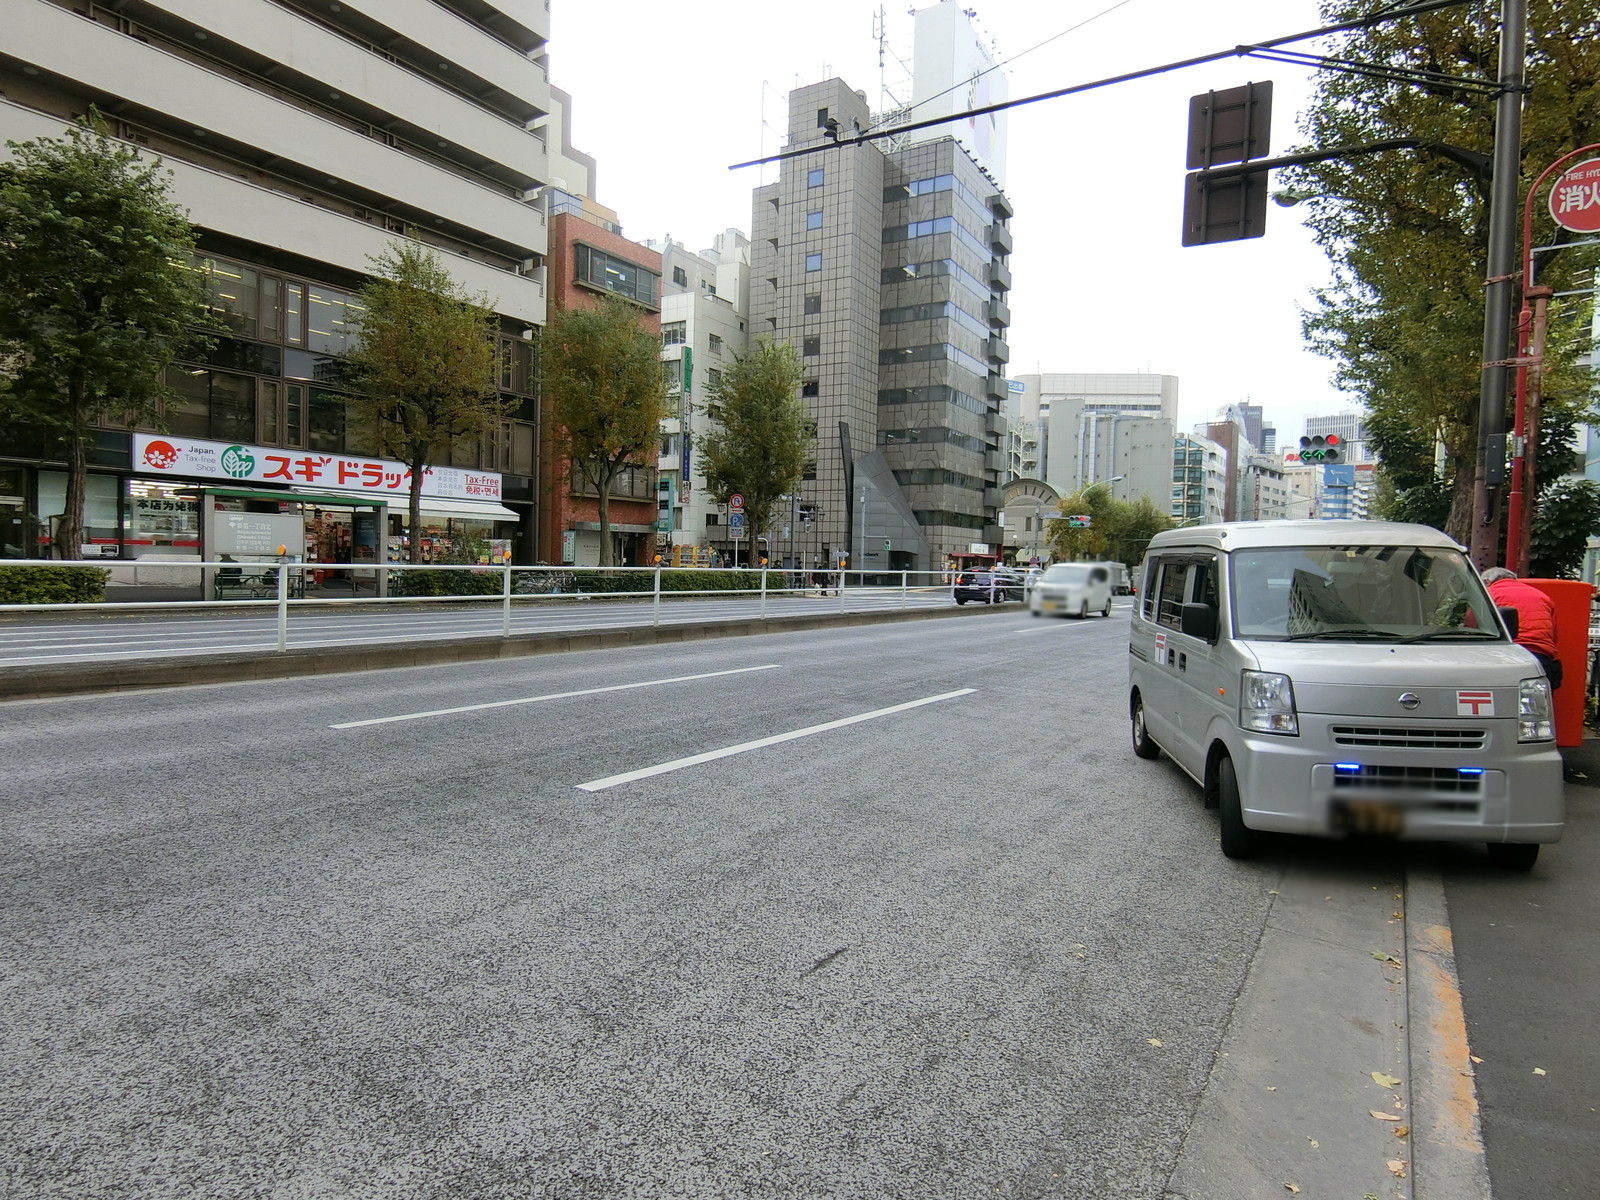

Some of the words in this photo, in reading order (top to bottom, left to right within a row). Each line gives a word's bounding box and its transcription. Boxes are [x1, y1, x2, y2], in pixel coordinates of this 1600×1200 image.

[1566, 171, 1584, 181] FIRE
[185, 454, 216, 464] Tax-free
[197, 464, 216, 472] Shop
[465, 474, 499, 485] Tax-Free
